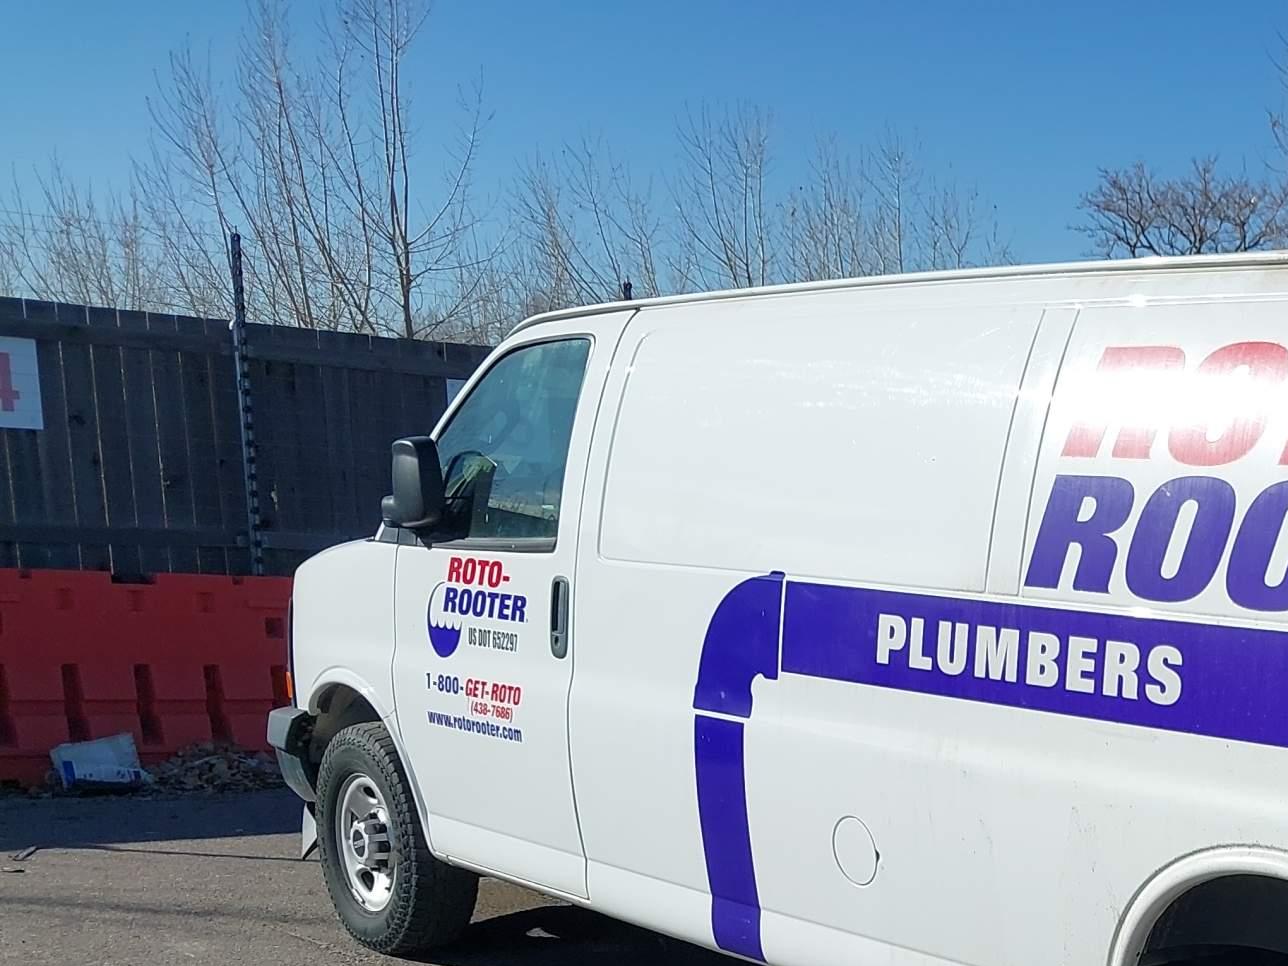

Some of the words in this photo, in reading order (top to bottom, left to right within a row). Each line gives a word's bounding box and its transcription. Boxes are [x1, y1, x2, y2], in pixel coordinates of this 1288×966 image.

[447, 557, 510, 588] ROTO-
[443, 587, 528, 623] ROOTER
[468, 627, 478, 646] US
[478, 629, 491, 649] DOT
[492, 630, 518, 653] 652297
[876, 613, 1184, 706] PLUMBERS
[427, 711, 523, 742] www.rotorooter.com
[470, 701, 513, 723] (438-7686)
